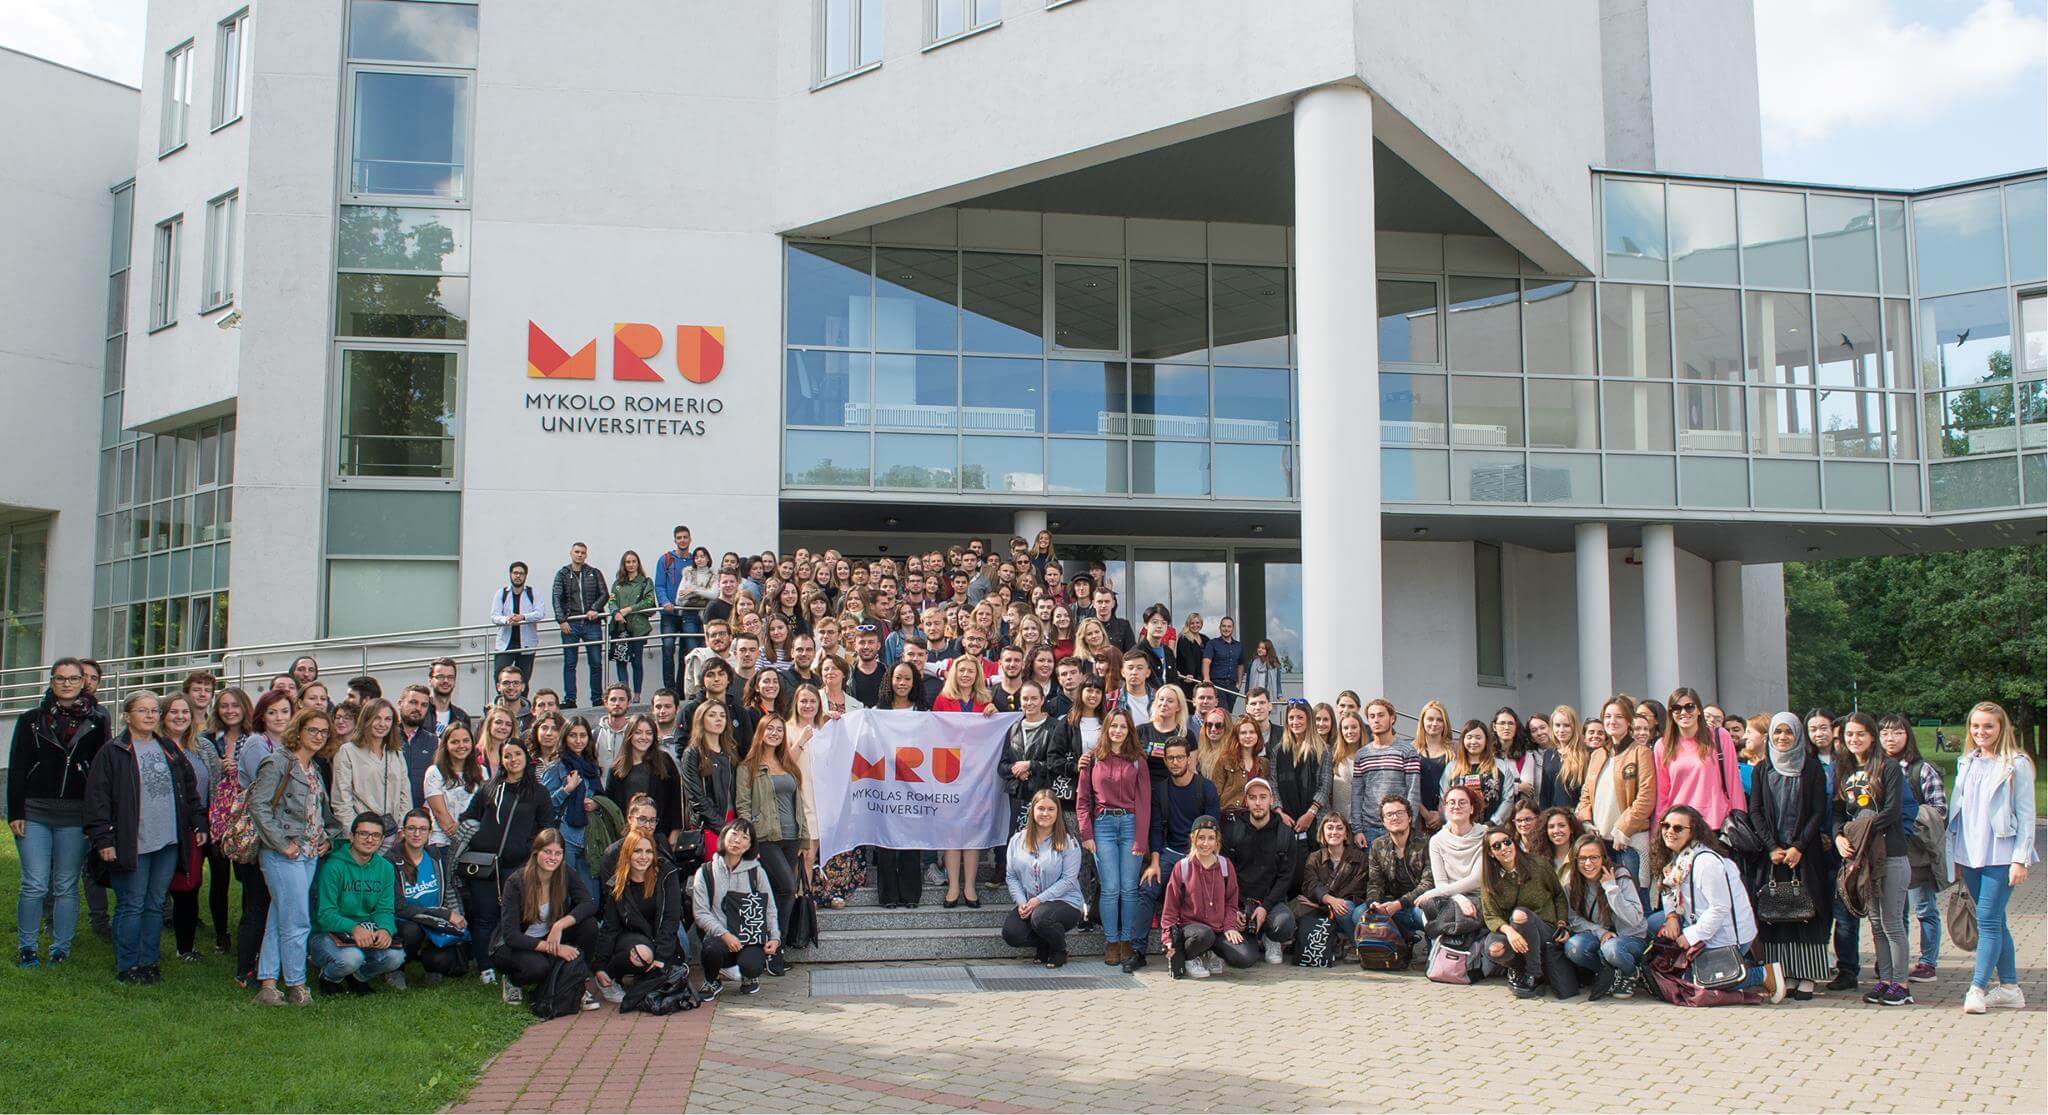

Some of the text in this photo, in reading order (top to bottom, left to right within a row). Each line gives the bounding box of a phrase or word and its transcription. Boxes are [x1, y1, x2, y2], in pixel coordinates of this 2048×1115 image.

[528, 319, 724, 384] MRU
[525, 393, 724, 415] MYKOLO ROMERIO
[541, 415, 706, 436] UNIVERSITETAS
[852, 747, 960, 783] MRU
[852, 789, 960, 803] MYKOLAS ROMERIS
[868, 802, 938, 816] UNIVERSITY
